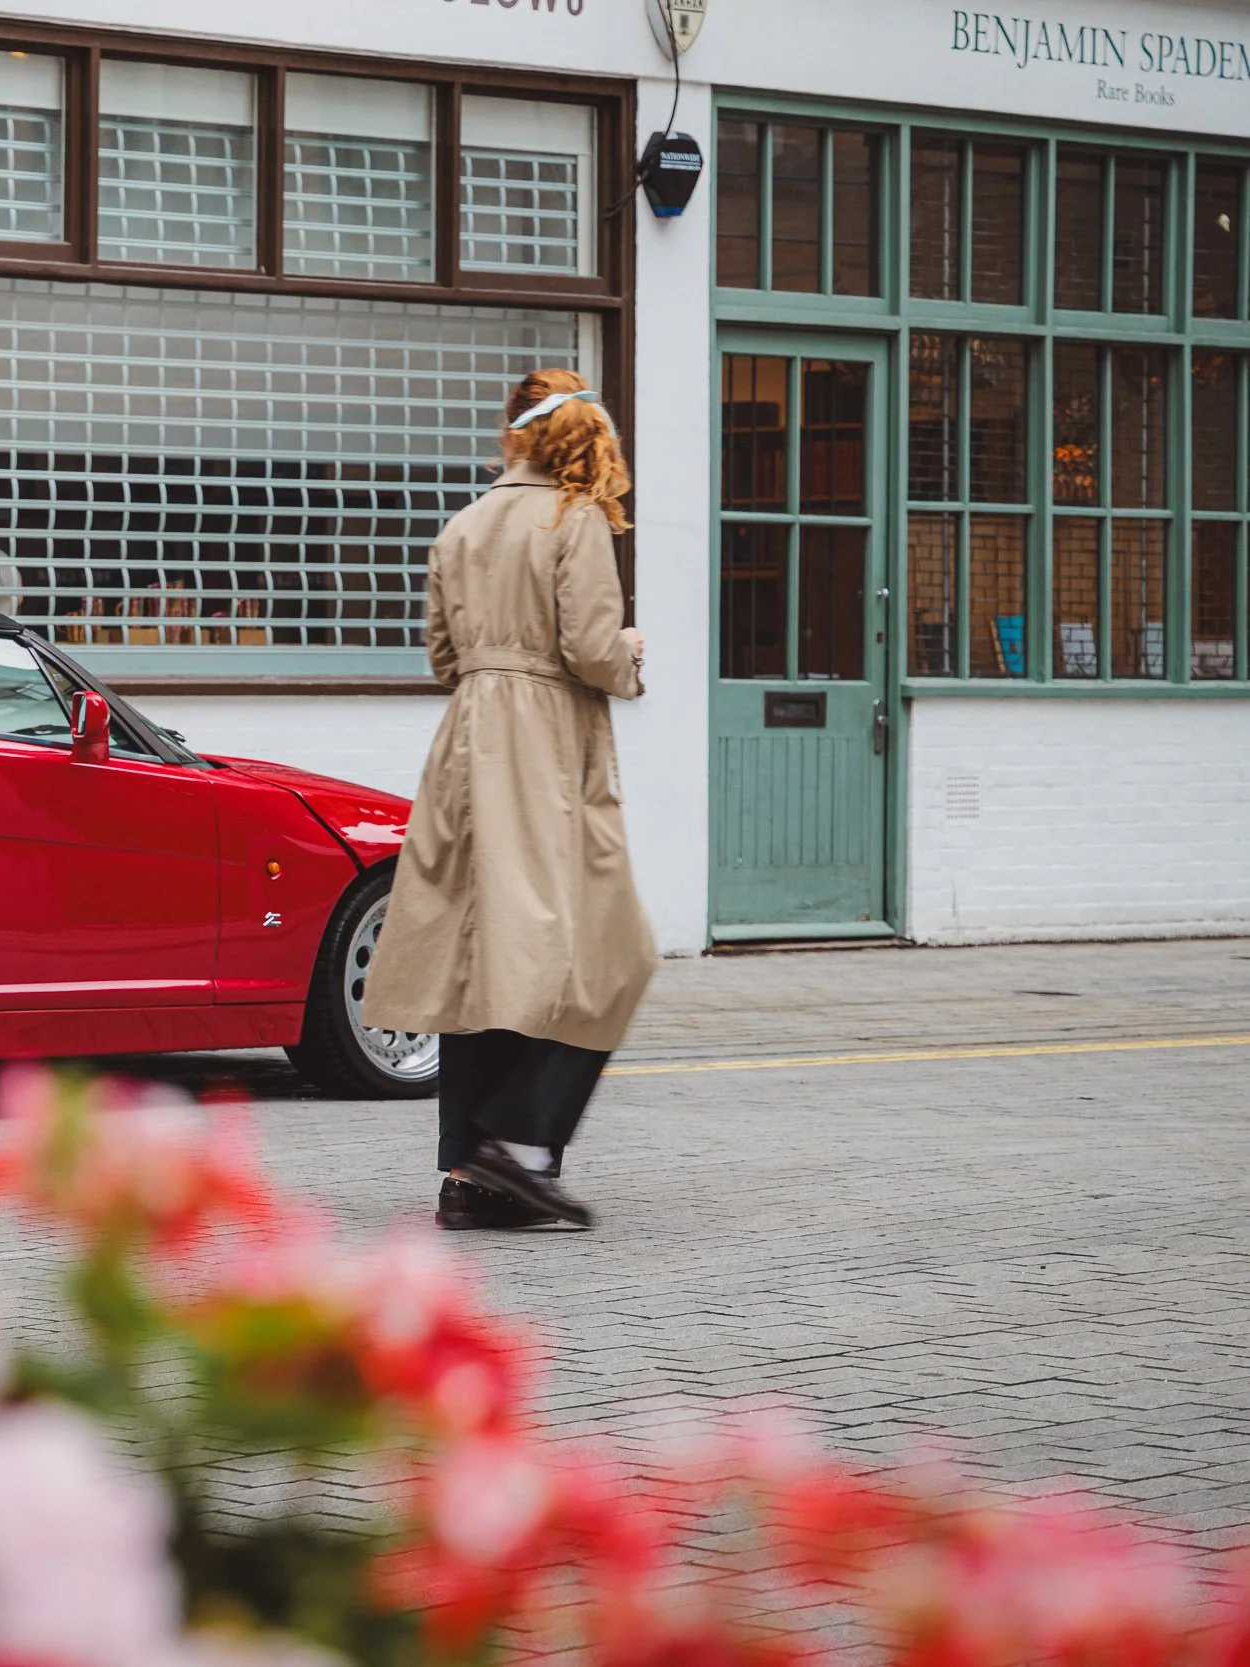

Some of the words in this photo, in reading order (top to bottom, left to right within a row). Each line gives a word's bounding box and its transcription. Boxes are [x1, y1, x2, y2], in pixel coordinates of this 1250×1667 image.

[951, 9, 1128, 69] BENJAMIN
[1096, 79, 1129, 101] Rare
[1134, 83, 1176, 106] Books
